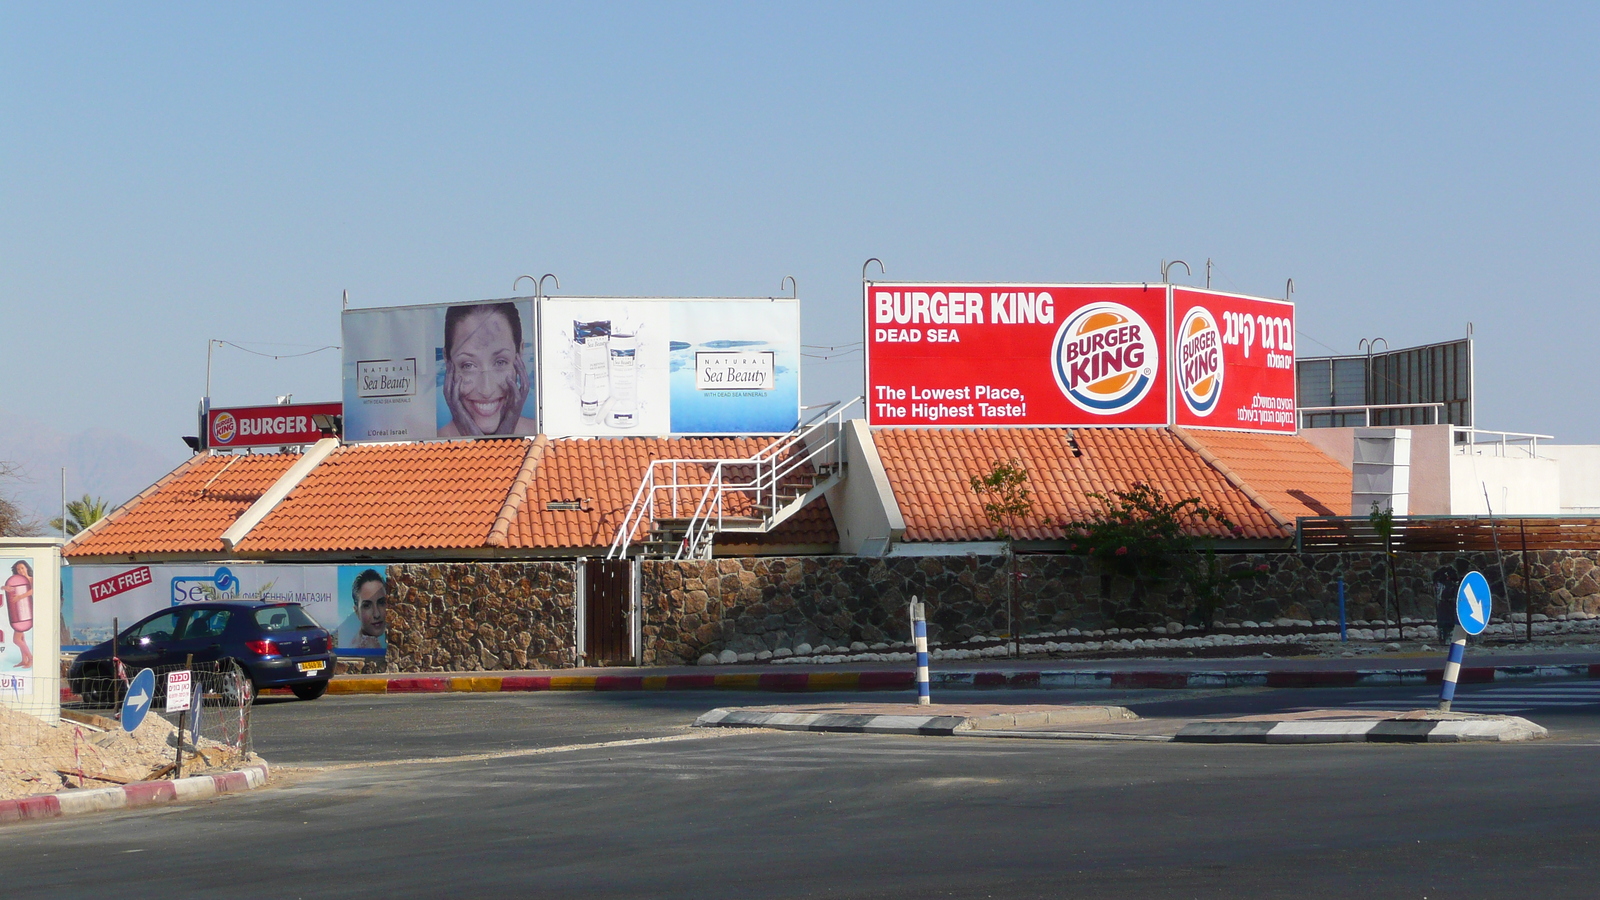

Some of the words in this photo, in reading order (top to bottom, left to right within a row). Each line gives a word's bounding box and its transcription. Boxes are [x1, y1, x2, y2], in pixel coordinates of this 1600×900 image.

[875, 292, 984, 324] BURGER
[991, 292, 1054, 324] KING
[875, 329, 922, 343] DEAD
[927, 329, 960, 343] SEA
[1223, 311, 1256, 359] קינג
[1257, 315, 1293, 351] ברגר
[1066, 325, 1141, 363] BURGER
[1183, 330, 1216, 364] BURGER
[1070, 342, 1145, 390] KING
[1184, 347, 1218, 390] KING
[1267, 350, 1284, 369] המלח
[1285, 356, 1292, 369] ים
[363, 375, 378, 390] Sea
[380, 375, 411, 392] Beauty
[704, 367, 723, 382] Sea
[726, 367, 767, 386] Beauty
[875, 385, 906, 400] The
[911, 385, 970, 400] Lowest
[975, 385, 1025, 402] Place,
[876, 403, 907, 418] The
[911, 403, 974, 420] Highest
[978, 403, 1026, 417] Taste!
[216, 422, 234, 436] KING
[240, 416, 307, 435] BURGER
[91, 580, 116, 599] TAX
[118, 568, 150, 590] FREE
[295, 592, 332, 603] МАГАЗИН
[170, 673, 188, 682] סכנה
